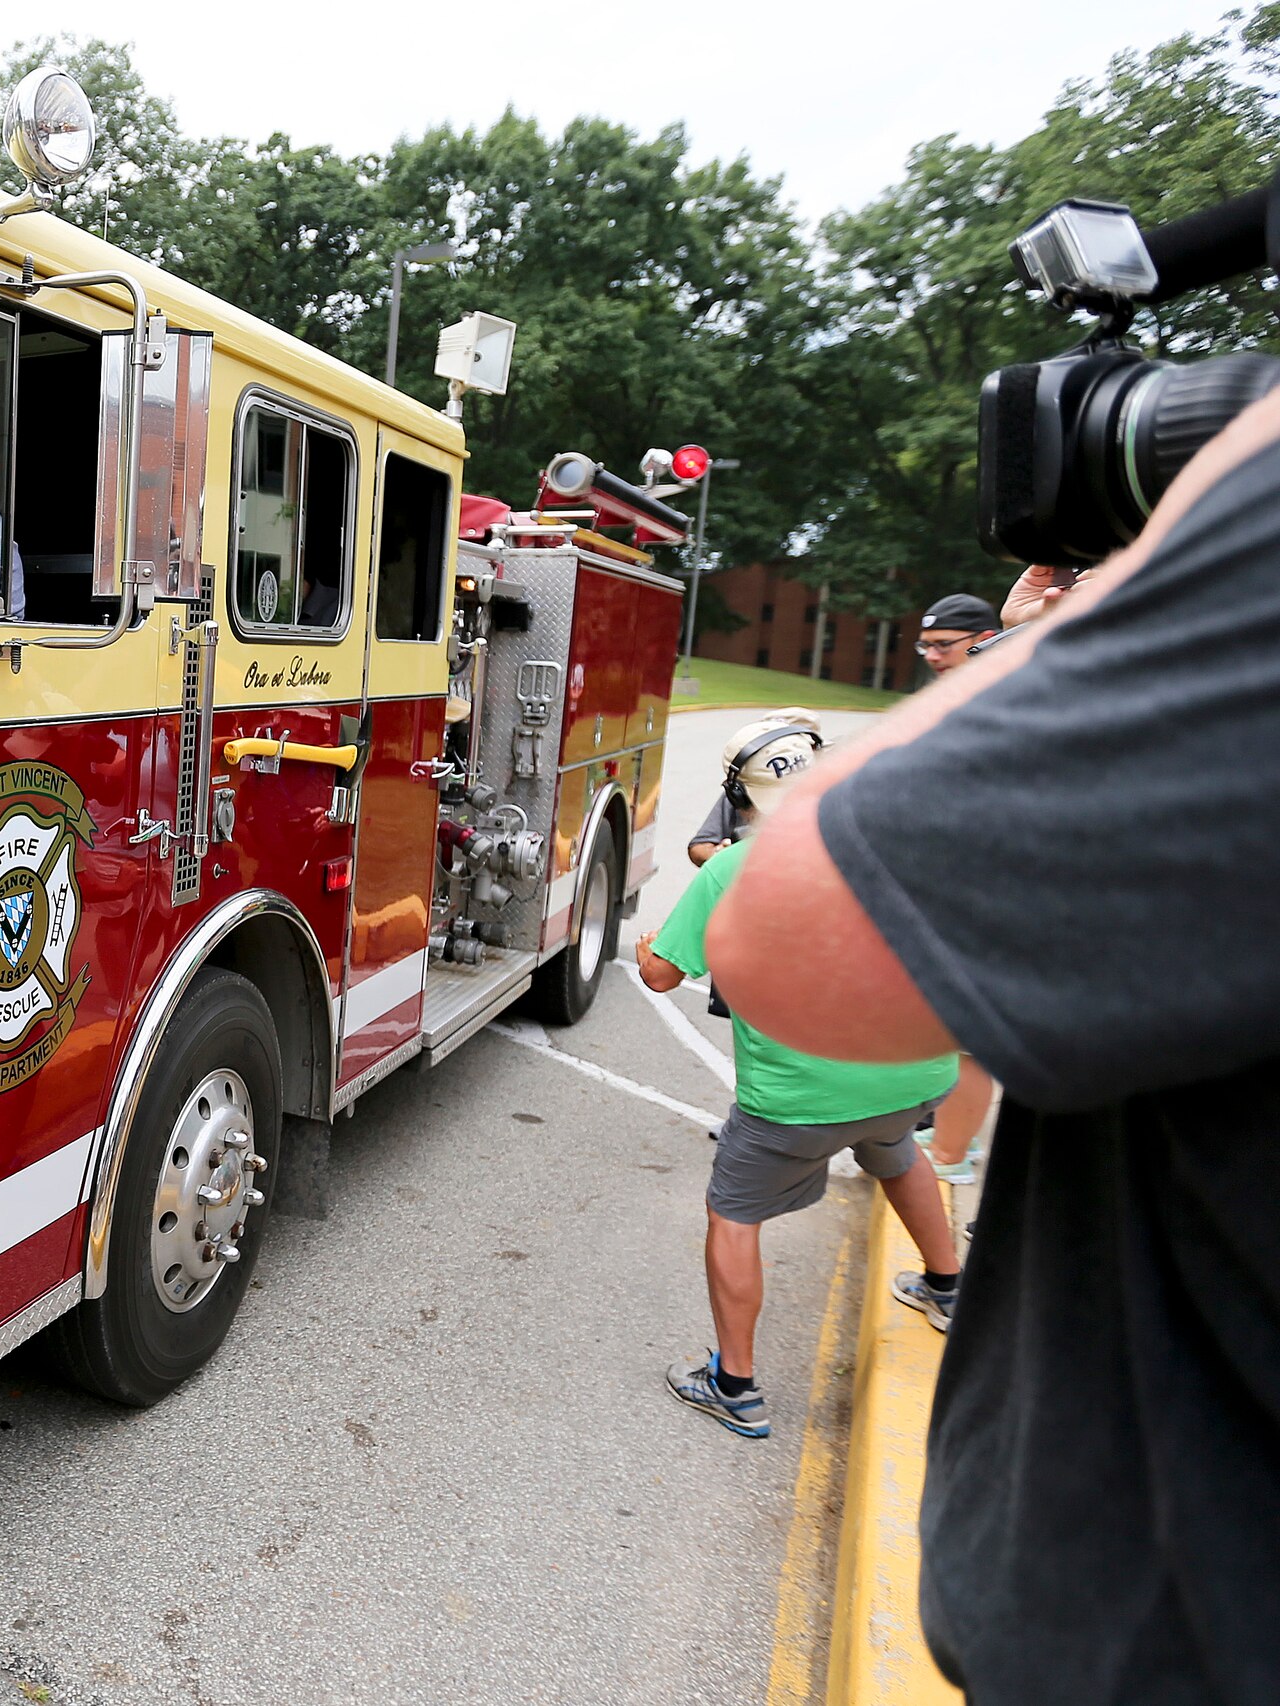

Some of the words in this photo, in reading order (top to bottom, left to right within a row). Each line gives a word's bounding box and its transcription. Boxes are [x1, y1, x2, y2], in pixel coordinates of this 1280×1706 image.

[243, 661, 269, 688] Ora
[271, 667, 285, 687] et
[286, 655, 332, 687] Labora
[11, 768, 68, 795] VINCENT
[0, 961, 29, 983] 1846
